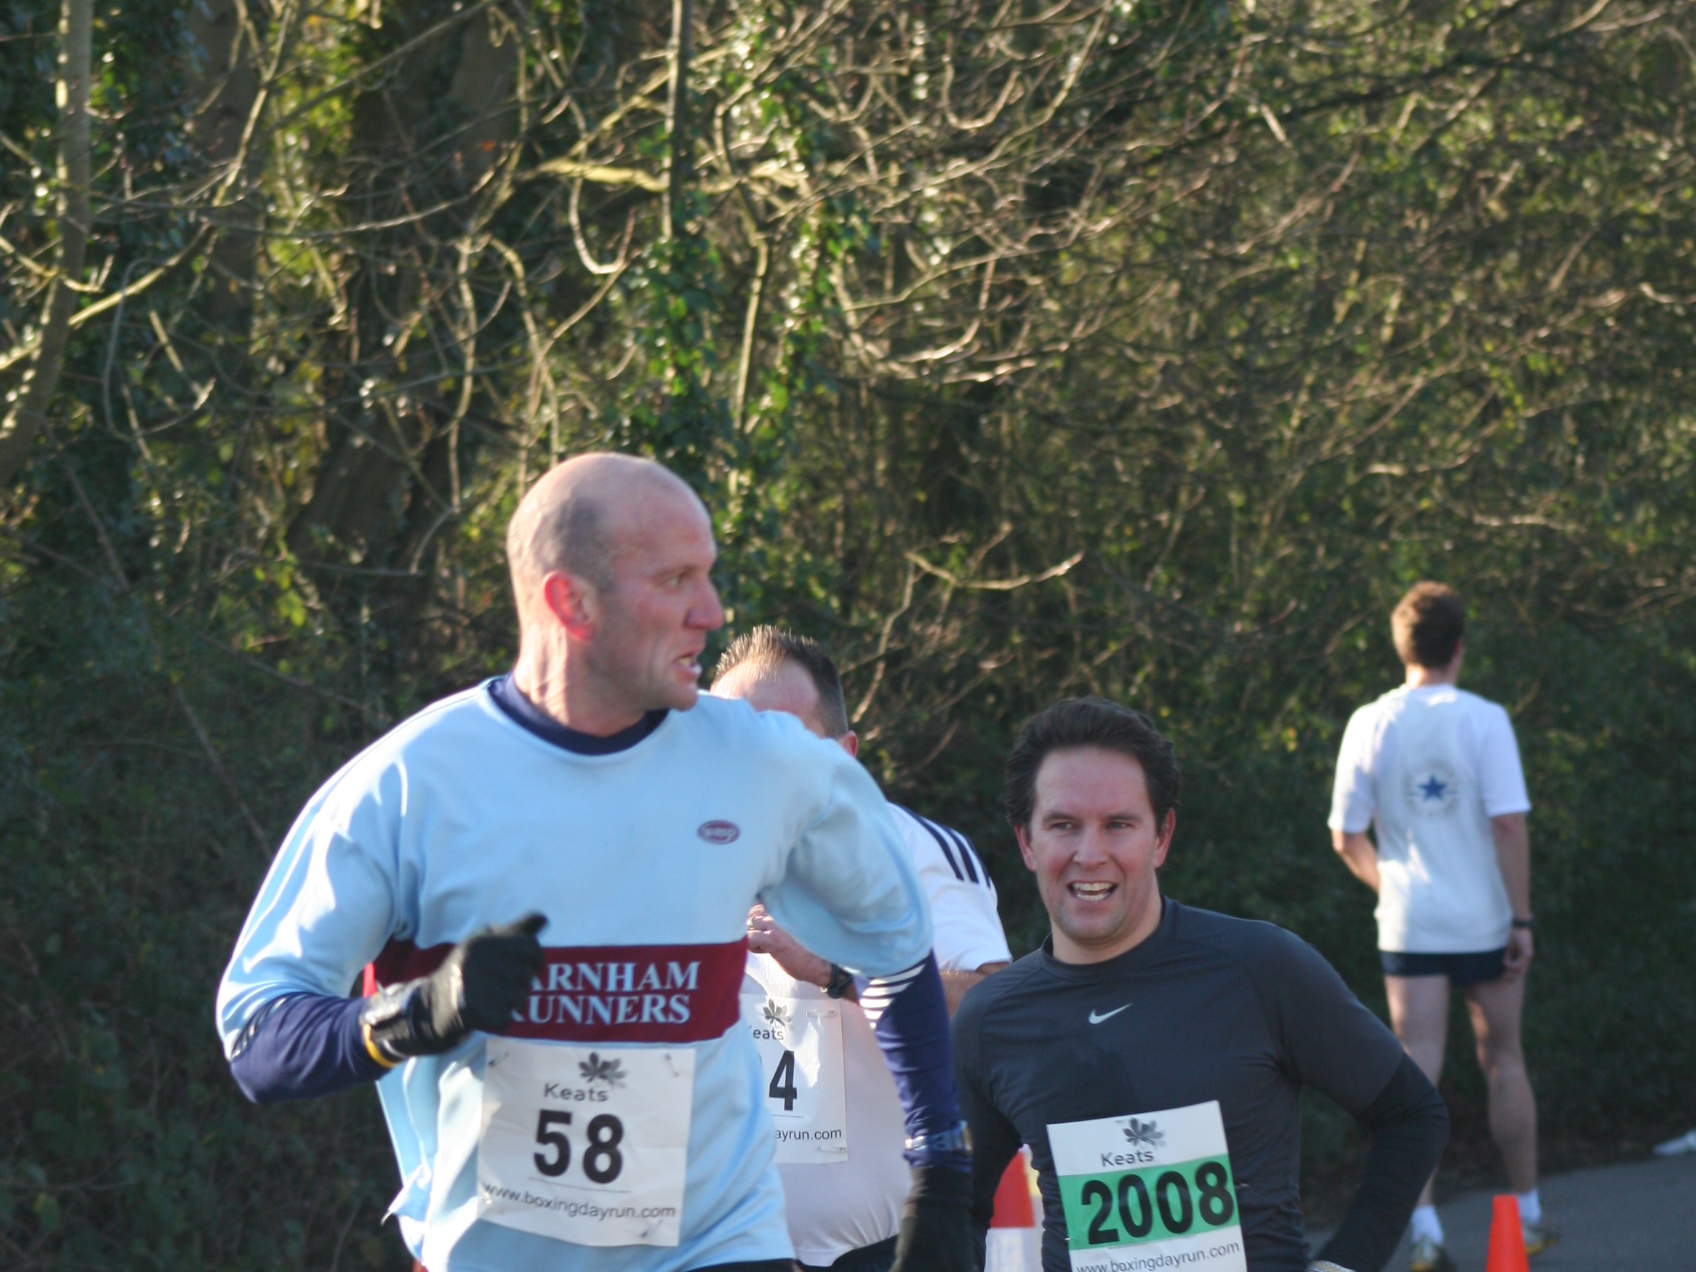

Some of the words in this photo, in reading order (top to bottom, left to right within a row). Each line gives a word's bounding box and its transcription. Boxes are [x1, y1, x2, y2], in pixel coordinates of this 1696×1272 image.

[749, 1026, 784, 1041] eats
[543, 1082, 609, 1102] Keats
[758, 1050, 798, 1111] 4
[533, 1108, 624, 1184] 58
[1101, 1150, 1154, 1168] Keats
[483, 1180, 676, 1221] www.boxingdayrun.com
[1081, 1161, 1234, 1245] 2008
